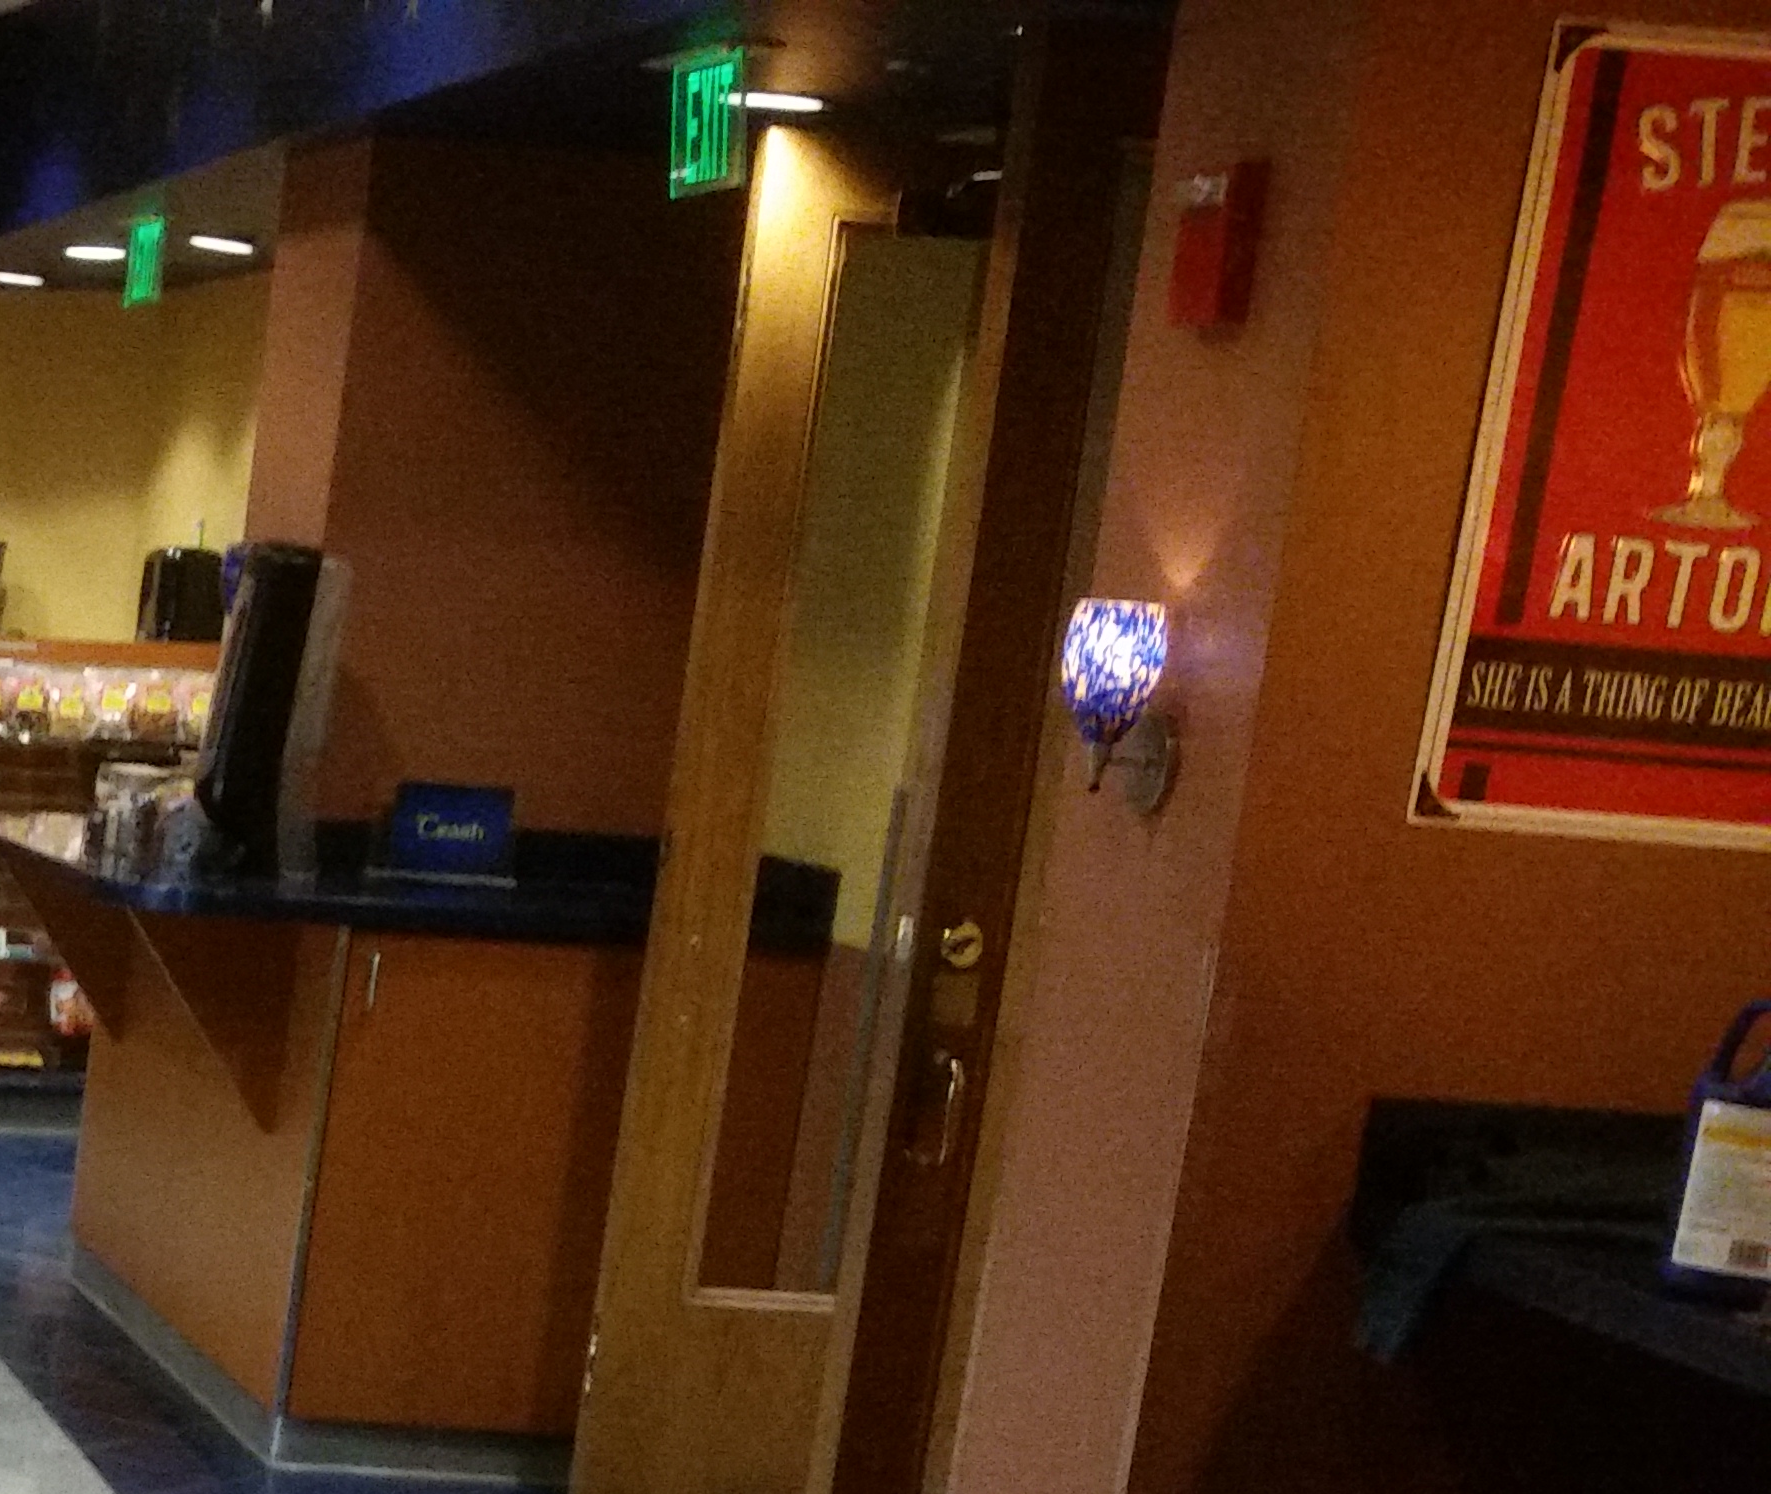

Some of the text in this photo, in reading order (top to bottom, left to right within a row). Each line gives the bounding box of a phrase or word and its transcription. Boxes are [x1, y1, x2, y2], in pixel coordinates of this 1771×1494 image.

[684, 62, 735, 185] EXIT
[1466, 661, 1524, 712] SHE
[1525, 665, 1553, 712] IS
[1554, 667, 1574, 713] A
[1582, 668, 1669, 721] THING
[1670, 677, 1710, 725] OF
